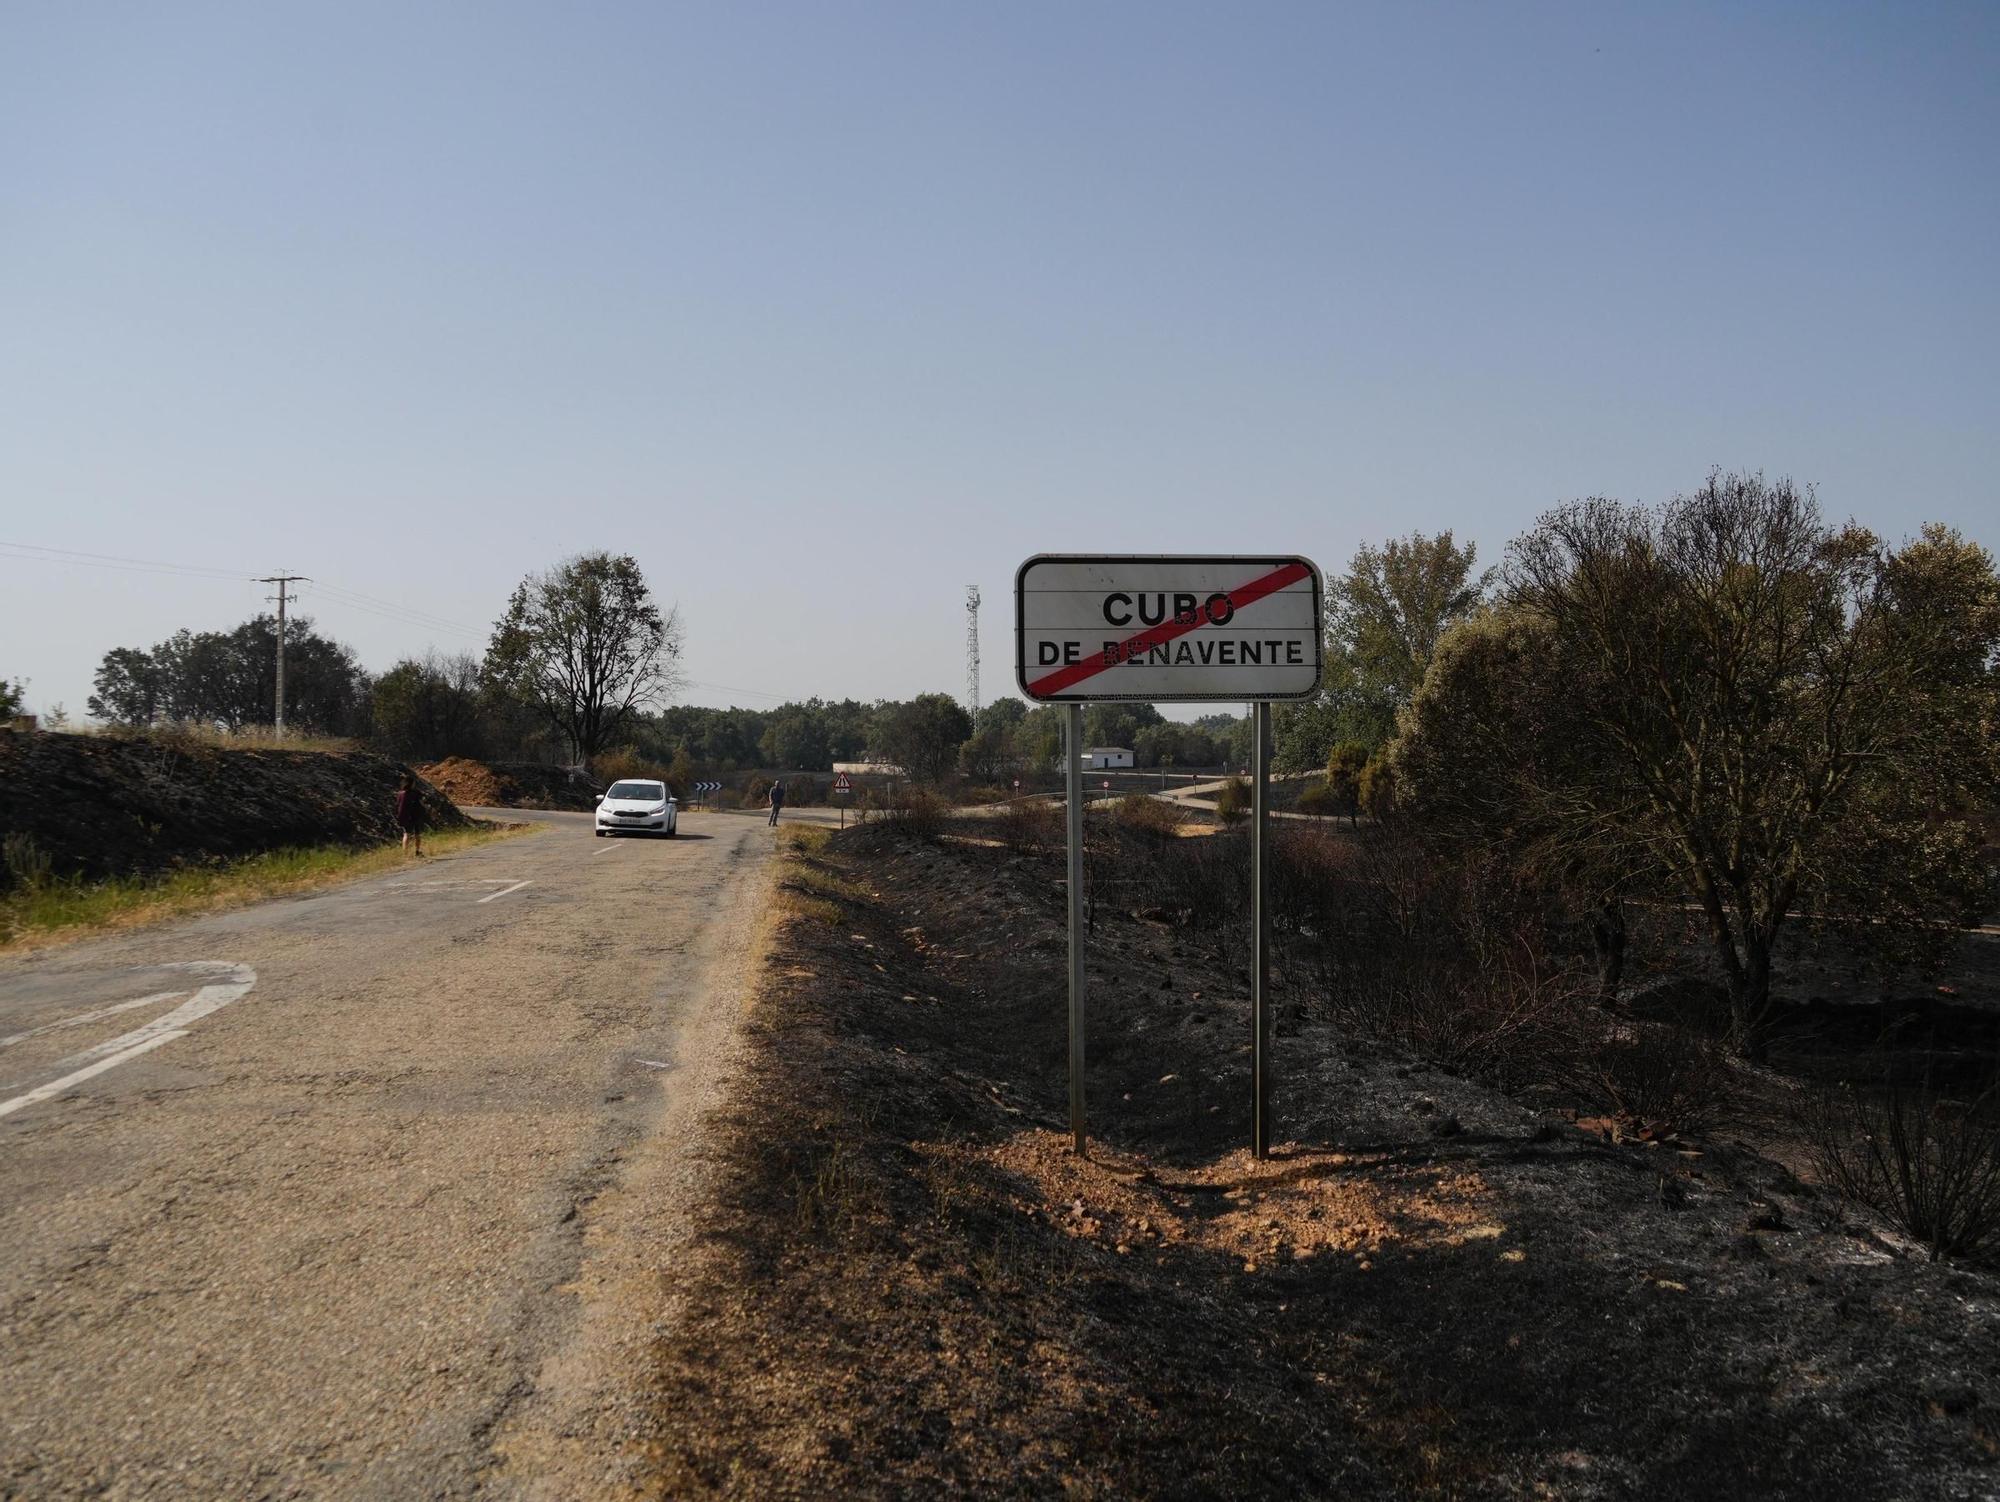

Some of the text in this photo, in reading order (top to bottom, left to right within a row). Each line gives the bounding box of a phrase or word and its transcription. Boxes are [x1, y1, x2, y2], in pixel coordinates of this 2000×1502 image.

[1103, 593, 1234, 626] CUBO
[1039, 641, 1303, 665] DE BENAVENTE
